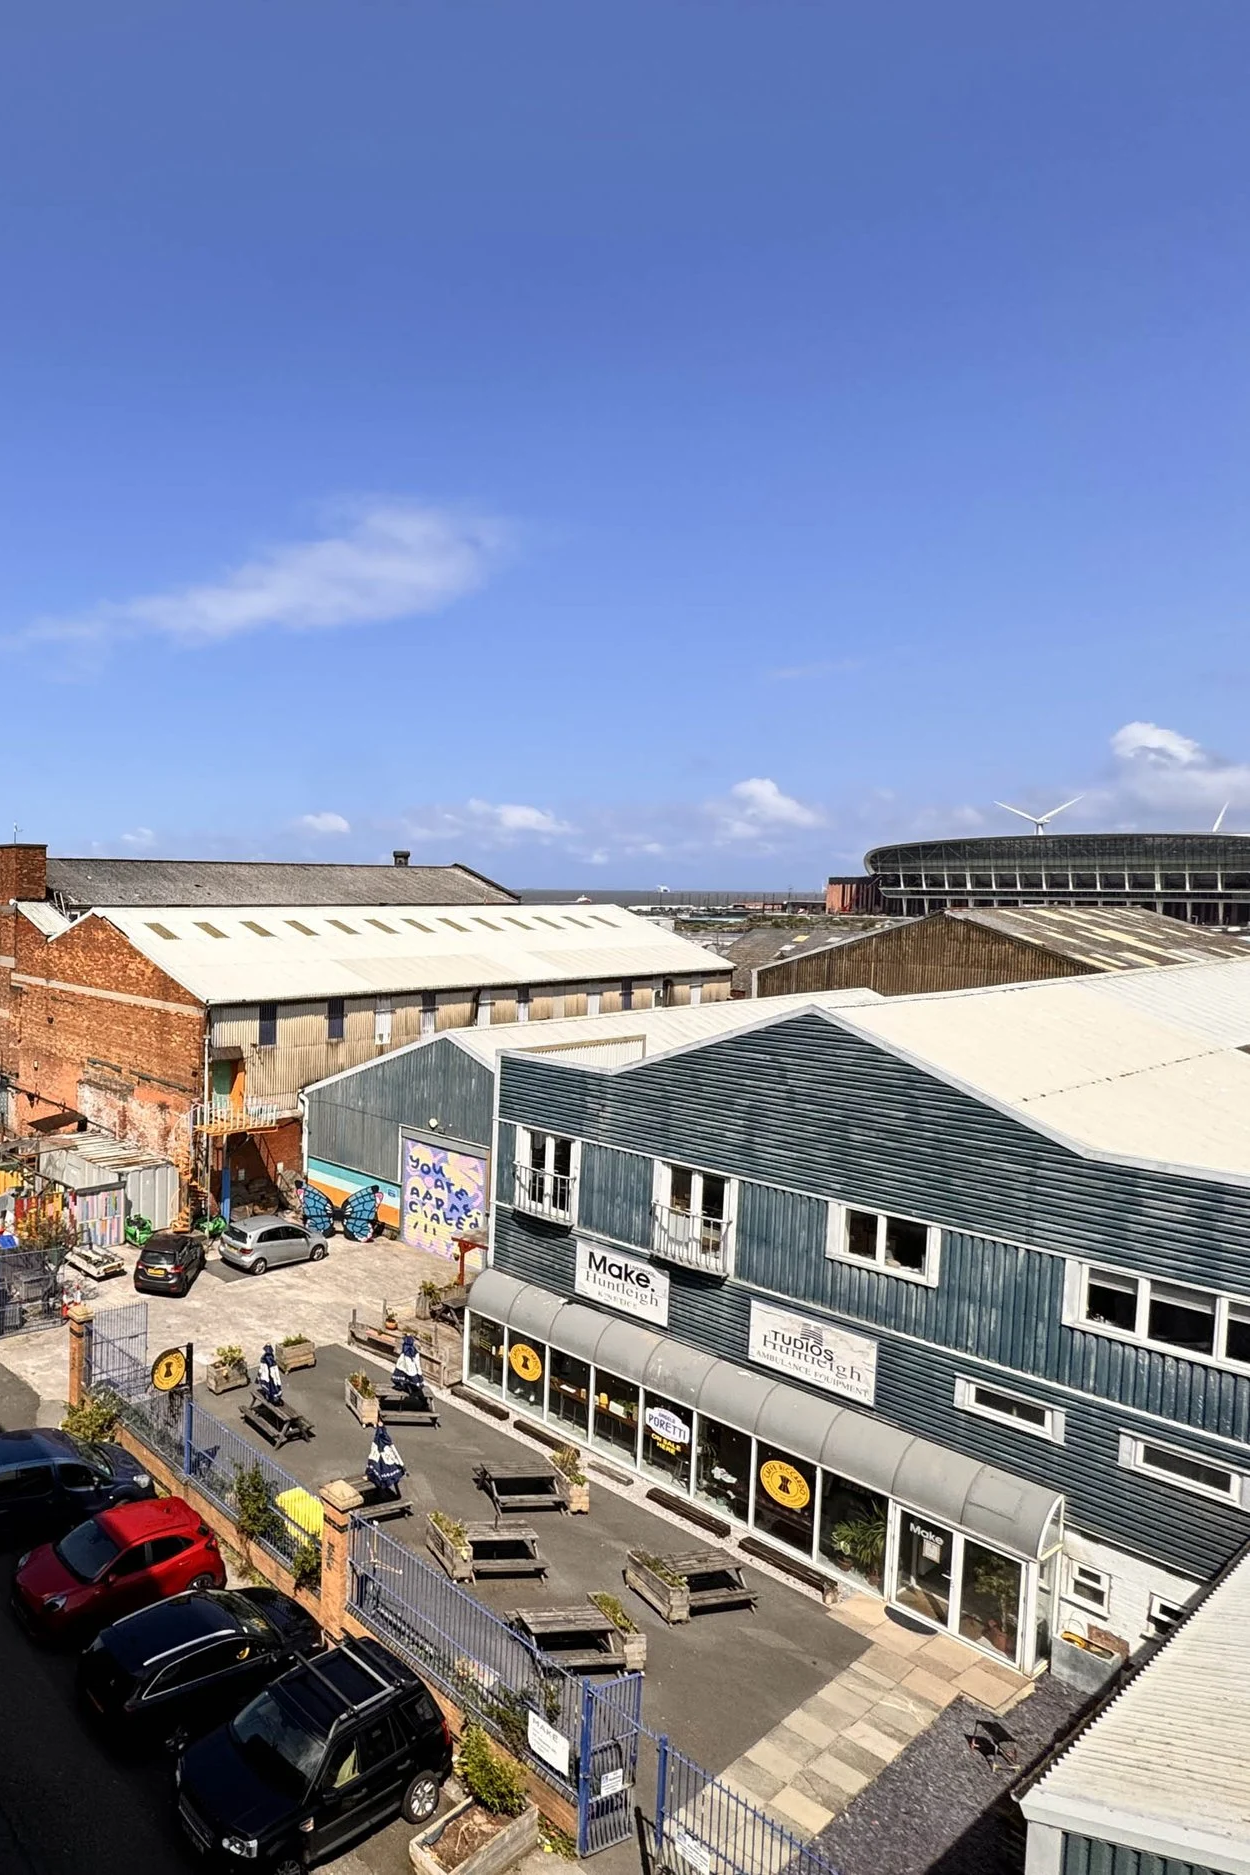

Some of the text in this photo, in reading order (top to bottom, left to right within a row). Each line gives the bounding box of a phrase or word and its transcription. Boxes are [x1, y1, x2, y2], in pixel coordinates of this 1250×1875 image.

[588, 1251, 655, 1292] Make.
[586, 1271, 658, 1307] Huntleigh
[771, 1330, 834, 1362] TUDIOS
[756, 1350, 811, 1376] AMBULANCE
[649, 1413, 686, 1440] PORETTI
[910, 1522, 944, 1546] Make
[533, 1717, 559, 1744] MAKE
